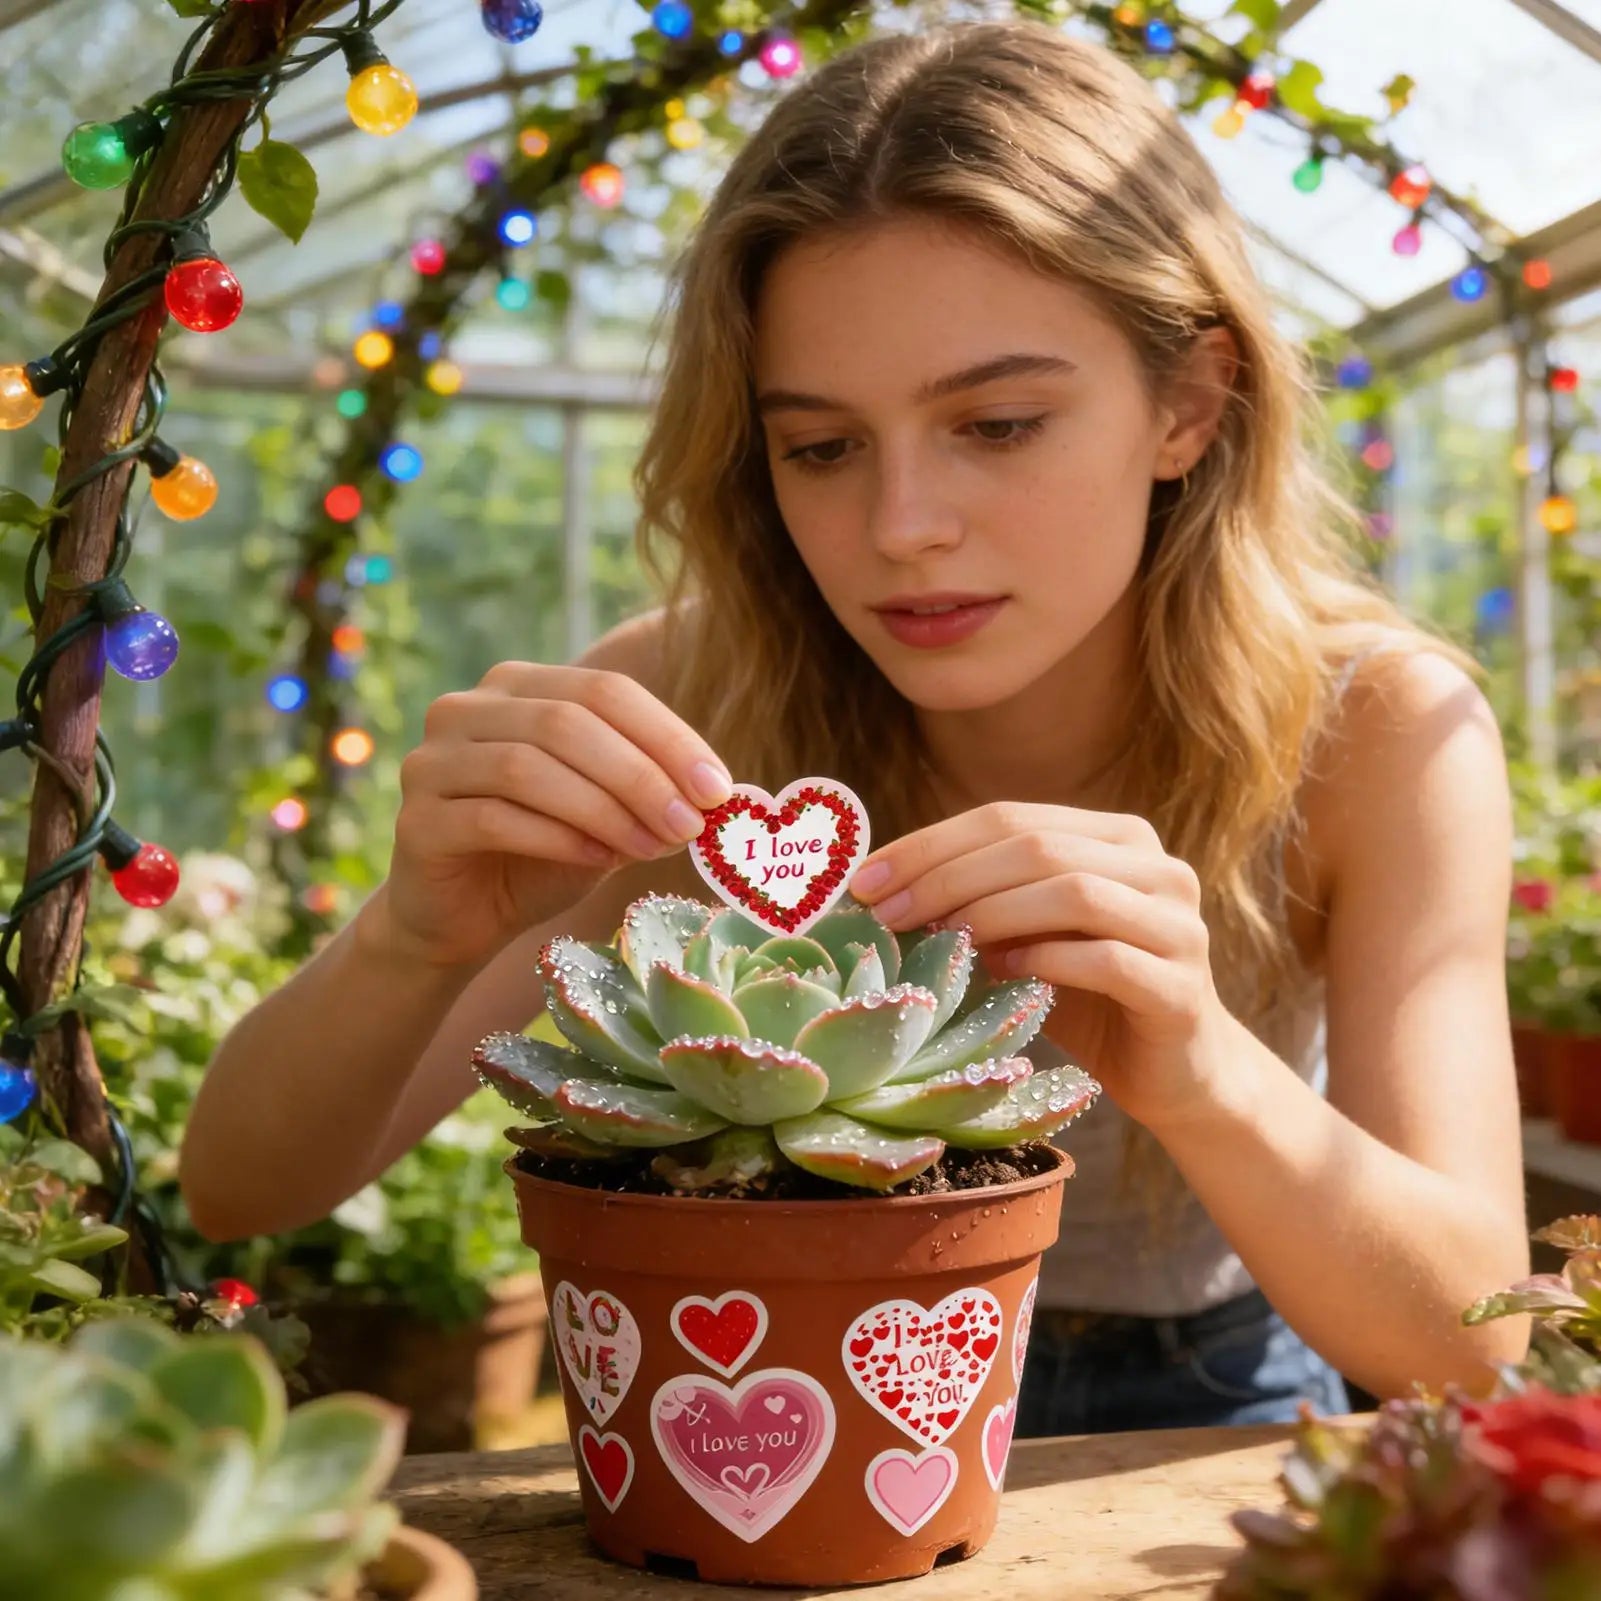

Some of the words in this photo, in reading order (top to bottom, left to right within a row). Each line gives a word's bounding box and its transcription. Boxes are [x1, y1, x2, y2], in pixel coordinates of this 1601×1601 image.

[744, 839, 757, 861] I
[771, 836, 824, 858] love
[760, 862, 805, 885] you
[894, 1324, 902, 1348] I
[896, 1349, 959, 1376] LOVE
[690, 1438, 696, 1454] I
[755, 1430, 797, 1452] you
